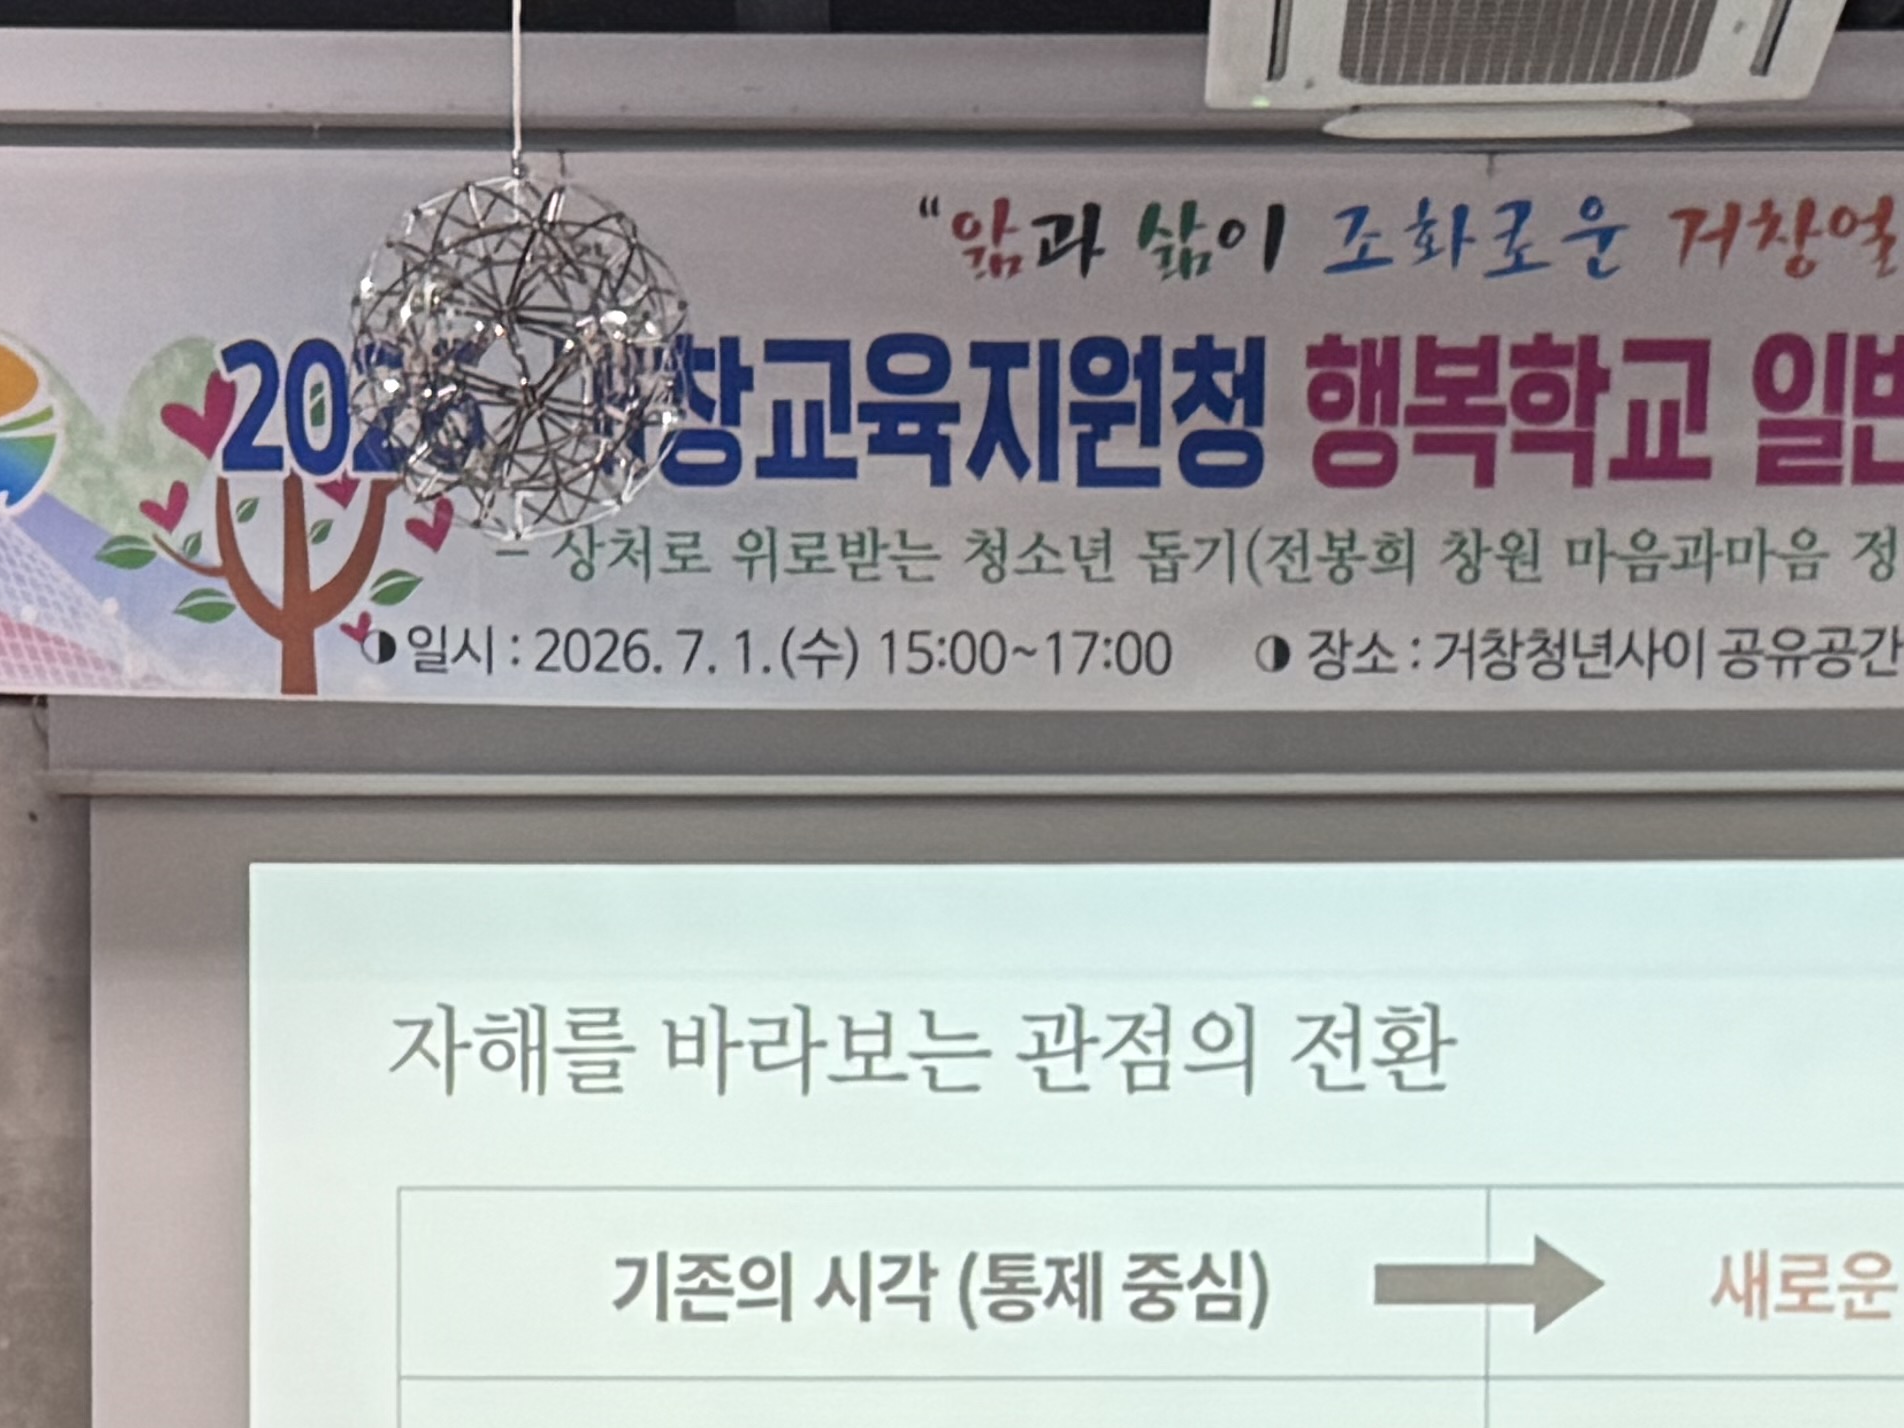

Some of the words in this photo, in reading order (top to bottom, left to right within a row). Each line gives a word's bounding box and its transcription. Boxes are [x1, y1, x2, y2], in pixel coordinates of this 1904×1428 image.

[1137, 200, 1286, 281] 삶이
[1323, 195, 1630, 279] 조화로운
[1305, 333, 1712, 489] 행복학교
[552, 524, 712, 584] 상처로
[732, 526, 942, 584] 위로받는
[964, 527, 1114, 584] 청소년
[1138, 527, 1414, 586] 돕기(전봉희
[1440, 528, 1542, 585] 창원
[1566, 527, 1829, 584] 마음과마음
[408, 625, 493, 675] 일시
[881, 628, 1172, 677] 15:00~17:00
[1309, 628, 1397, 681] 장소
[1434, 627, 1704, 681] 거창청년사이
[1718, 624, 1904, 680] 공유공간
[389, 1002, 637, 1096] 자해를
[662, 1003, 993, 1097] 바라보는
[1016, 1002, 1254, 1097] 관점의
[1291, 1001, 1458, 1093] 전환
[612, 1250, 792, 1323] 기존의
[814, 1250, 939, 1323] 시각
[959, 1250, 1103, 1331] (통제
[1122, 1250, 1269, 1331] 중심)
[1711, 1249, 1898, 1321] 새로운
